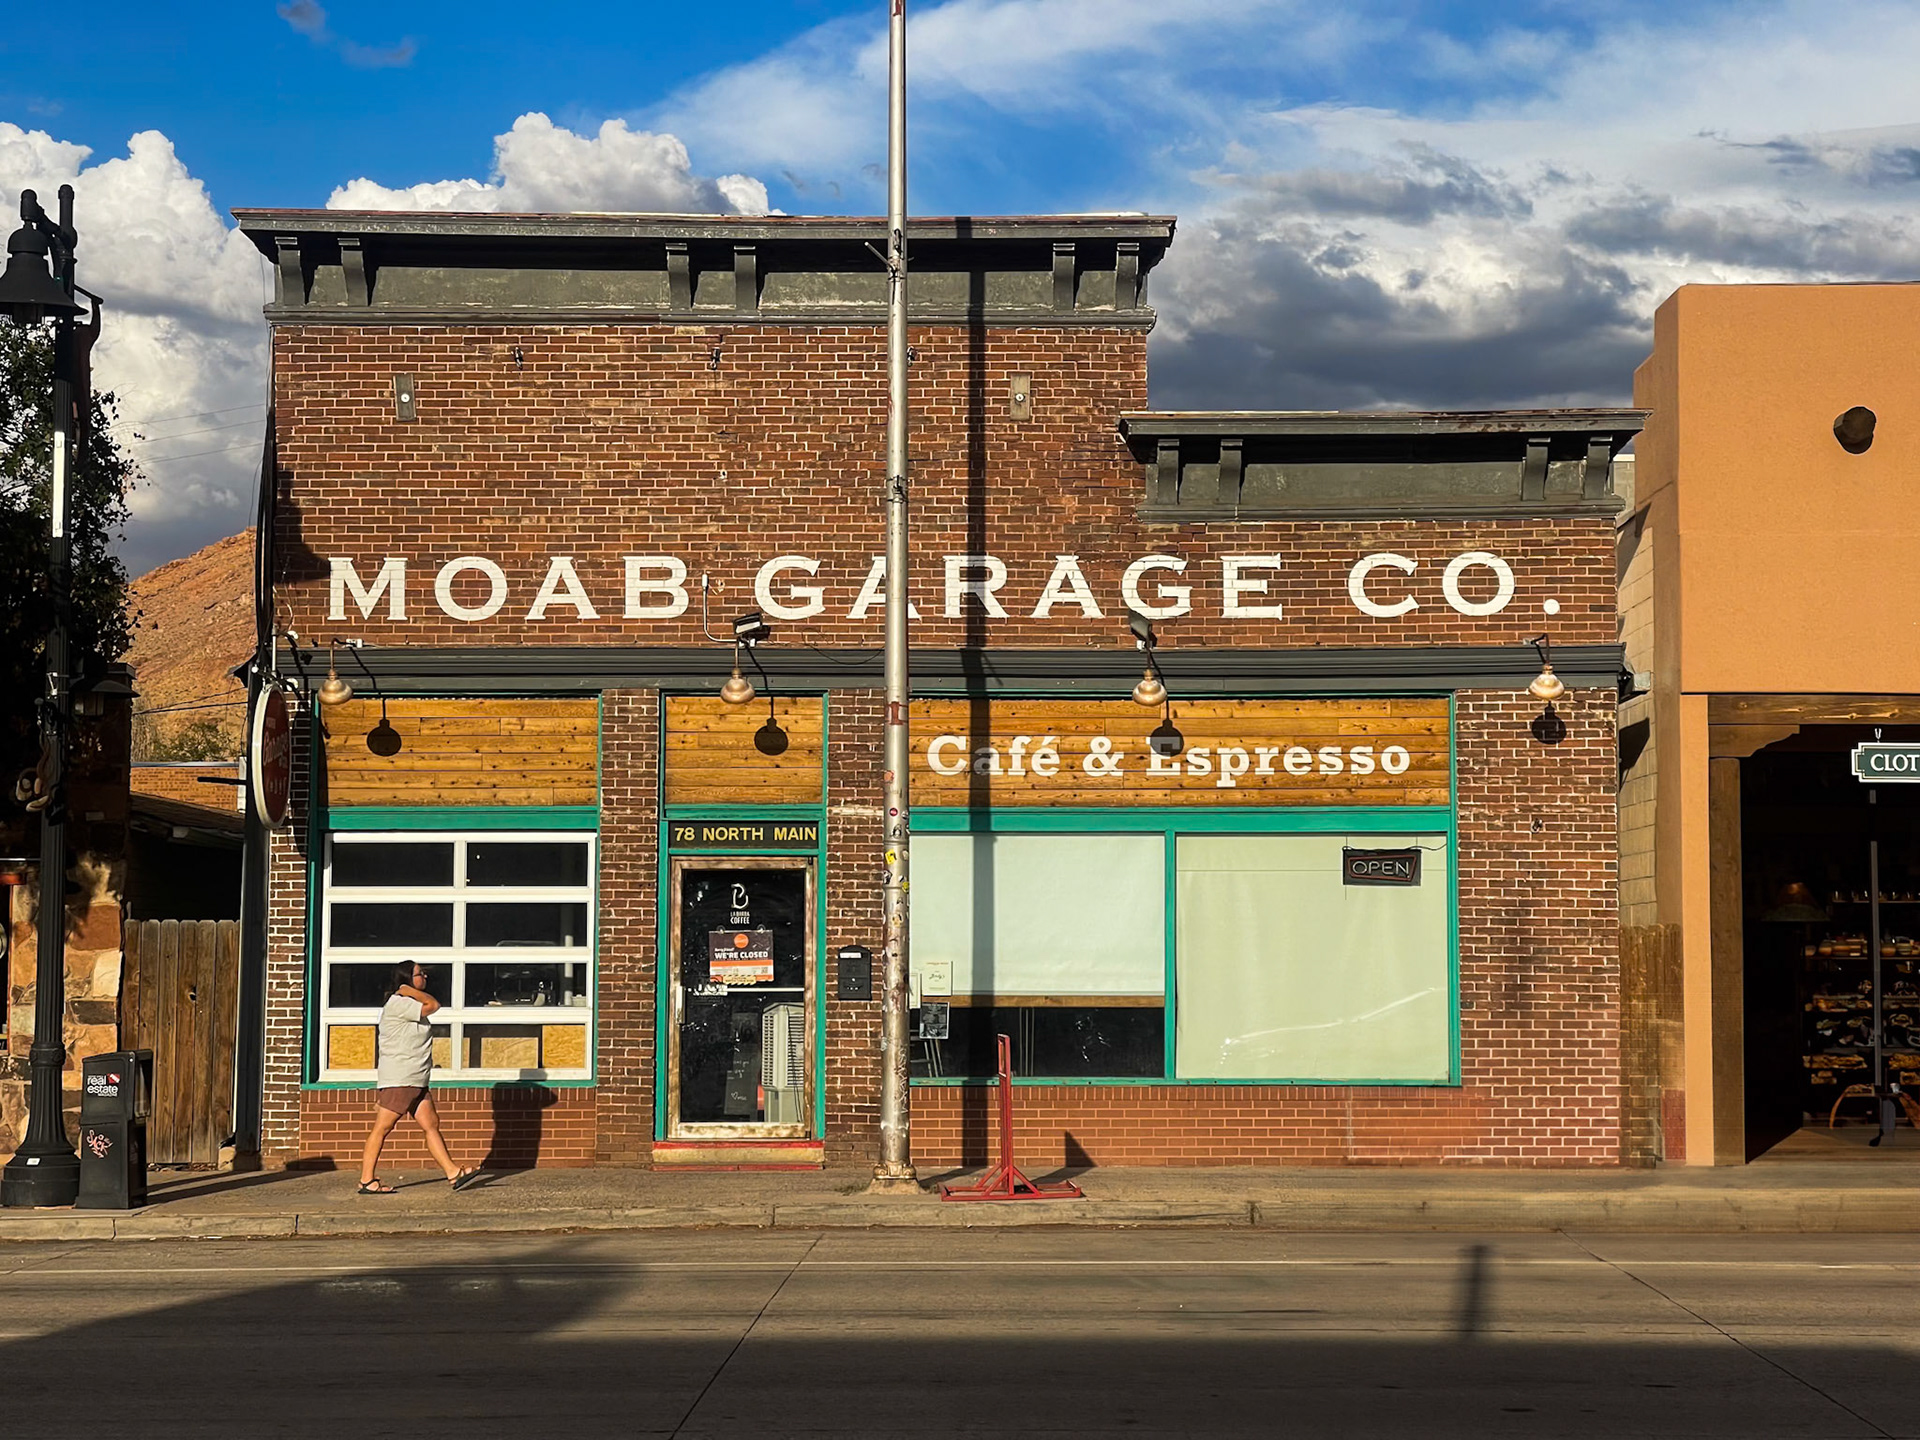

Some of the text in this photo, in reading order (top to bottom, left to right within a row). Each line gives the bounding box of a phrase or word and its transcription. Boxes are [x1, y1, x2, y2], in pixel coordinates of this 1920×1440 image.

[327, 551, 1561, 622] MOAB GARAGE CO.
[926, 734, 1411, 788] Café & Espresso
[1870, 753, 1920, 772] CLOT
[674, 827, 817, 841] 78 NORTH MAIN
[1352, 861, 1409, 875] OPEN
[730, 916, 750, 925] COFFEE
[714, 951, 769, 960] WE'RE CLOSED
[87, 1075, 107, 1085] real
[87, 1085, 119, 1094] estate
